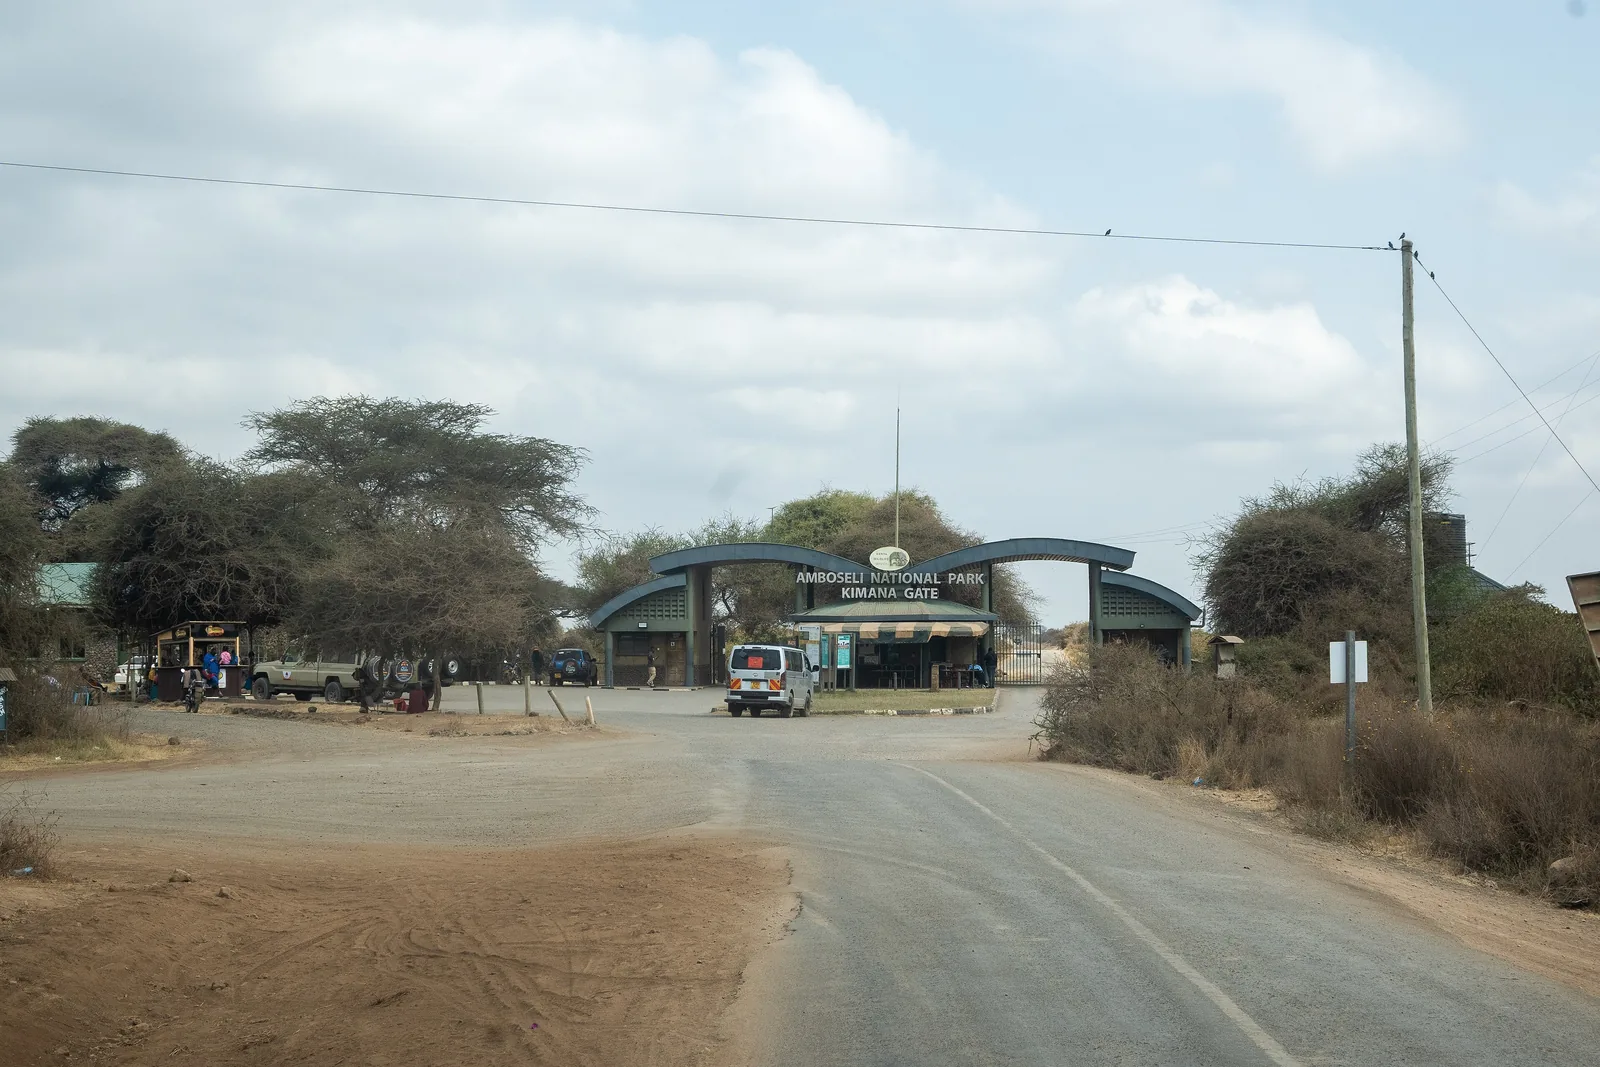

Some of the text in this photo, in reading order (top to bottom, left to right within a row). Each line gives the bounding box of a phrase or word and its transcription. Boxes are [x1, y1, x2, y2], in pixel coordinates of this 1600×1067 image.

[796, 571, 985, 585] AMBOSELI NATIONAL PARK
[841, 587, 939, 600] KIMANA GATE
